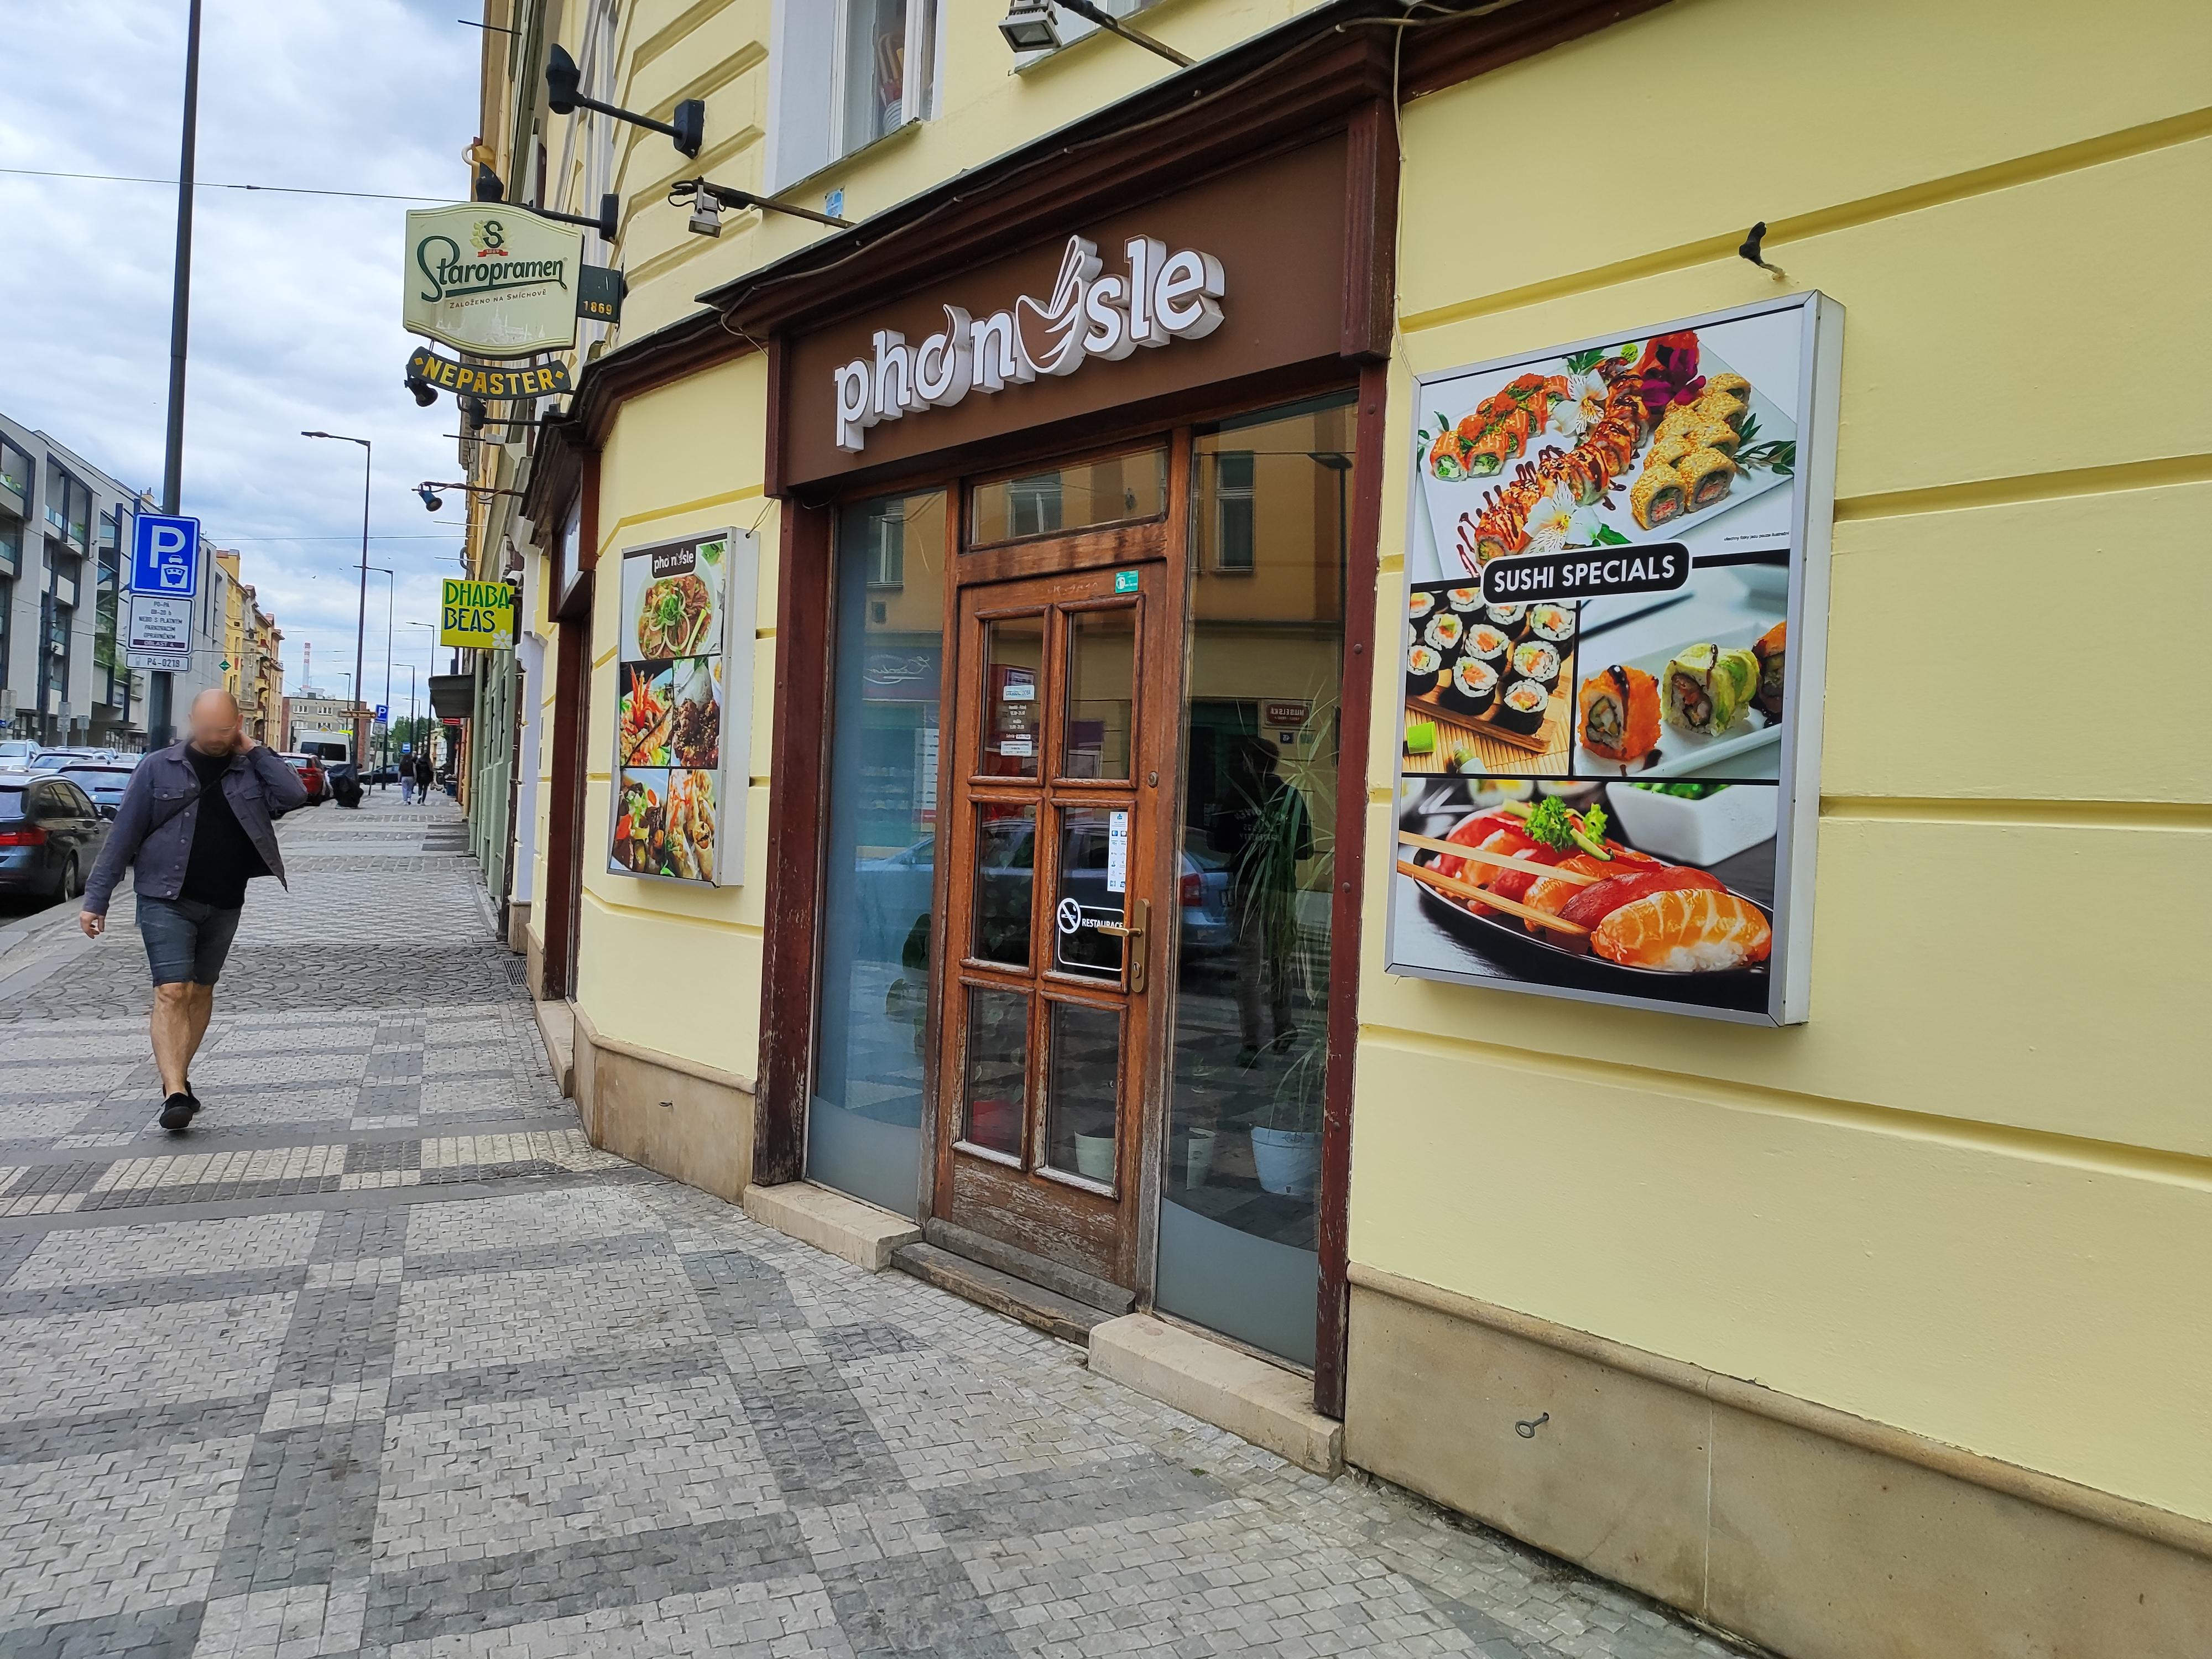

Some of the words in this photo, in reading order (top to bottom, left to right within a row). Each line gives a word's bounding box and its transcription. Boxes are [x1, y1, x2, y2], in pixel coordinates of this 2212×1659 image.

[417, 236, 568, 302] Staropramen
[582, 300, 613, 316] 1869
[422, 356, 556, 395] NEPASTER
[149, 525, 186, 568] P
[1494, 566, 1554, 593] SUSHI
[1562, 555, 1675, 586] SPECIALS
[445, 581, 510, 609] DHABA
[444, 607, 495, 633] BEAS
[378, 706, 387, 717] P
